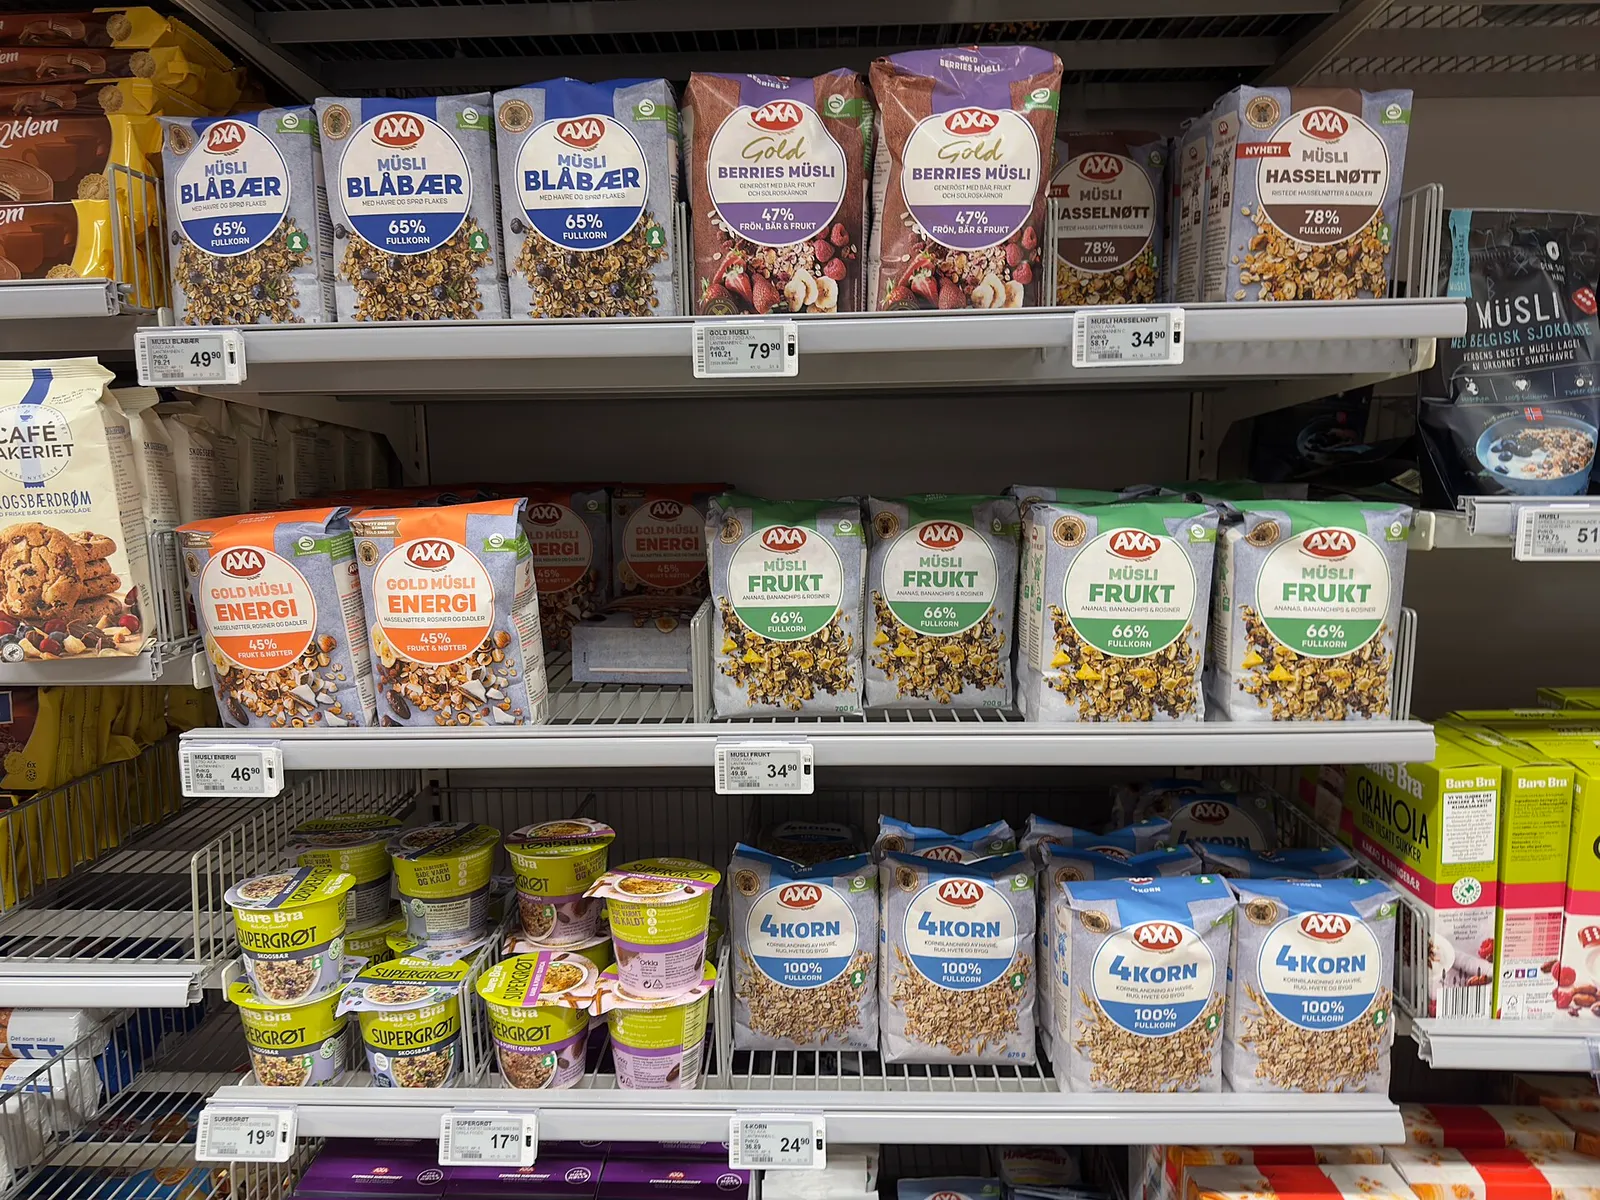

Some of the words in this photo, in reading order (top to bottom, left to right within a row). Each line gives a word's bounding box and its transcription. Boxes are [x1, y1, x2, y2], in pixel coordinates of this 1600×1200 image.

[756, 104, 799, 122] AXA
[379, 118, 420, 138] AXA
[950, 112, 994, 130] AXA
[1307, 112, 1343, 133] AXA
[209, 125, 242, 147] AXA
[562, 121, 601, 140] AXA
[741, 137, 806, 163] Gold
[938, 139, 1004, 164] Gold
[1245, 146, 1281, 155] NYHET!
[1302, 148, 1348, 163] MÜSLI
[205, 160, 247, 177] MÜSLI
[377, 155, 426, 171] MÜSLI
[558, 154, 606, 169] MÜSLI
[1083, 156, 1119, 173] AXA
[719, 167, 784, 178] BERRIES
[789, 163, 835, 177] MÜSLI
[913, 168, 981, 180] BERRIES
[986, 165, 1030, 179] MÜSLI
[1266, 169, 1381, 184] HASSELNØTT
[347, 172, 463, 197] BLÅBÆR
[525, 167, 640, 191] BLÅBÆR
[181, 177, 281, 204] BLÅBÆR
[1080, 187, 1122, 201] MÜSLI
[566, 214, 603, 229] 65%
[762, 208, 794, 221] 47%
[956, 211, 988, 225] 47%
[1305, 210, 1339, 224] 78%
[213, 221, 246, 236] 65%
[389, 220, 425, 234] 65%
[740, 222, 763, 231] FRÖN,
[765, 222, 781, 230] BÄR
[932, 226, 956, 234] FRÖN,
[958, 225, 975, 233] BÄR
[1300, 227, 1342, 235] FULLKORN
[211, 237, 250, 247] FULLKORN
[387, 236, 430, 244] FULLKORN
[563, 232, 607, 240] FULLKORN
[1085, 242, 1115, 254] 78%
[1476, 292, 1560, 329] MÜSLI
[1470, 329, 1521, 347] BELGISK
[1528, 322, 1592, 341] SJOKOADE
[1526, 351, 1574, 365] SVARTHAVRE
[767, 529, 802, 545] AXA
[923, 525, 959, 541] AXA
[1114, 532, 1156, 551] AXA
[1307, 532, 1351, 550] AXA
[412, 543, 451, 561] AXA
[226, 551, 262, 570] AXA
[764, 558, 806, 571] MÜSLI
[920, 555, 962, 567] MÜSLI
[903, 571, 978, 587] FRUKT
[1109, 566, 1158, 580] MÜSLI
[1302, 565, 1353, 579] MÜSLI
[387, 578, 428, 590] GOLD
[431, 575, 475, 589] MÜSLI
[749, 574, 823, 592] FRUKT
[211, 587, 246, 600] GOLD
[249, 582, 293, 597] MÜSLI
[1089, 584, 1175, 603] FRUKT
[1283, 583, 1371, 603] FRUKT
[215, 599, 298, 621] ENERGI
[388, 594, 476, 613] ENERGI
[771, 612, 803, 624] 66%
[924, 607, 956, 618] 66%
[420, 633, 451, 643] 45%
[1112, 625, 1149, 638] 66%
[1306, 624, 1344, 638] 66%
[249, 639, 277, 650] 45%
[1108, 640, 1151, 648] FULLKORN
[1302, 640, 1347, 648] FULLKORN
[1446, 779, 1474, 789] Bare
[1476, 777, 1496, 788] Bra
[1357, 776, 1428, 849] GRANOLA
[783, 886, 818, 902] AXA
[943, 882, 979, 899] AXA
[238, 910, 271, 924] Bare
[274, 912, 304, 923] Bra
[1305, 915, 1346, 934] AXA
[238, 926, 317, 948] SUPERGRØT
[1139, 925, 1177, 944] AXA
[372, 968, 462, 979] SUPERGRØT
[784, 962, 822, 973] 100%
[942, 963, 981, 974] 100%
[378, 1012, 416, 1022] Bare
[420, 1004, 445, 1019] Bra
[1134, 1008, 1177, 1021] 100%
[1302, 1001, 1344, 1013] 100%
[372, 1016, 454, 1046] SUPERGRØT
